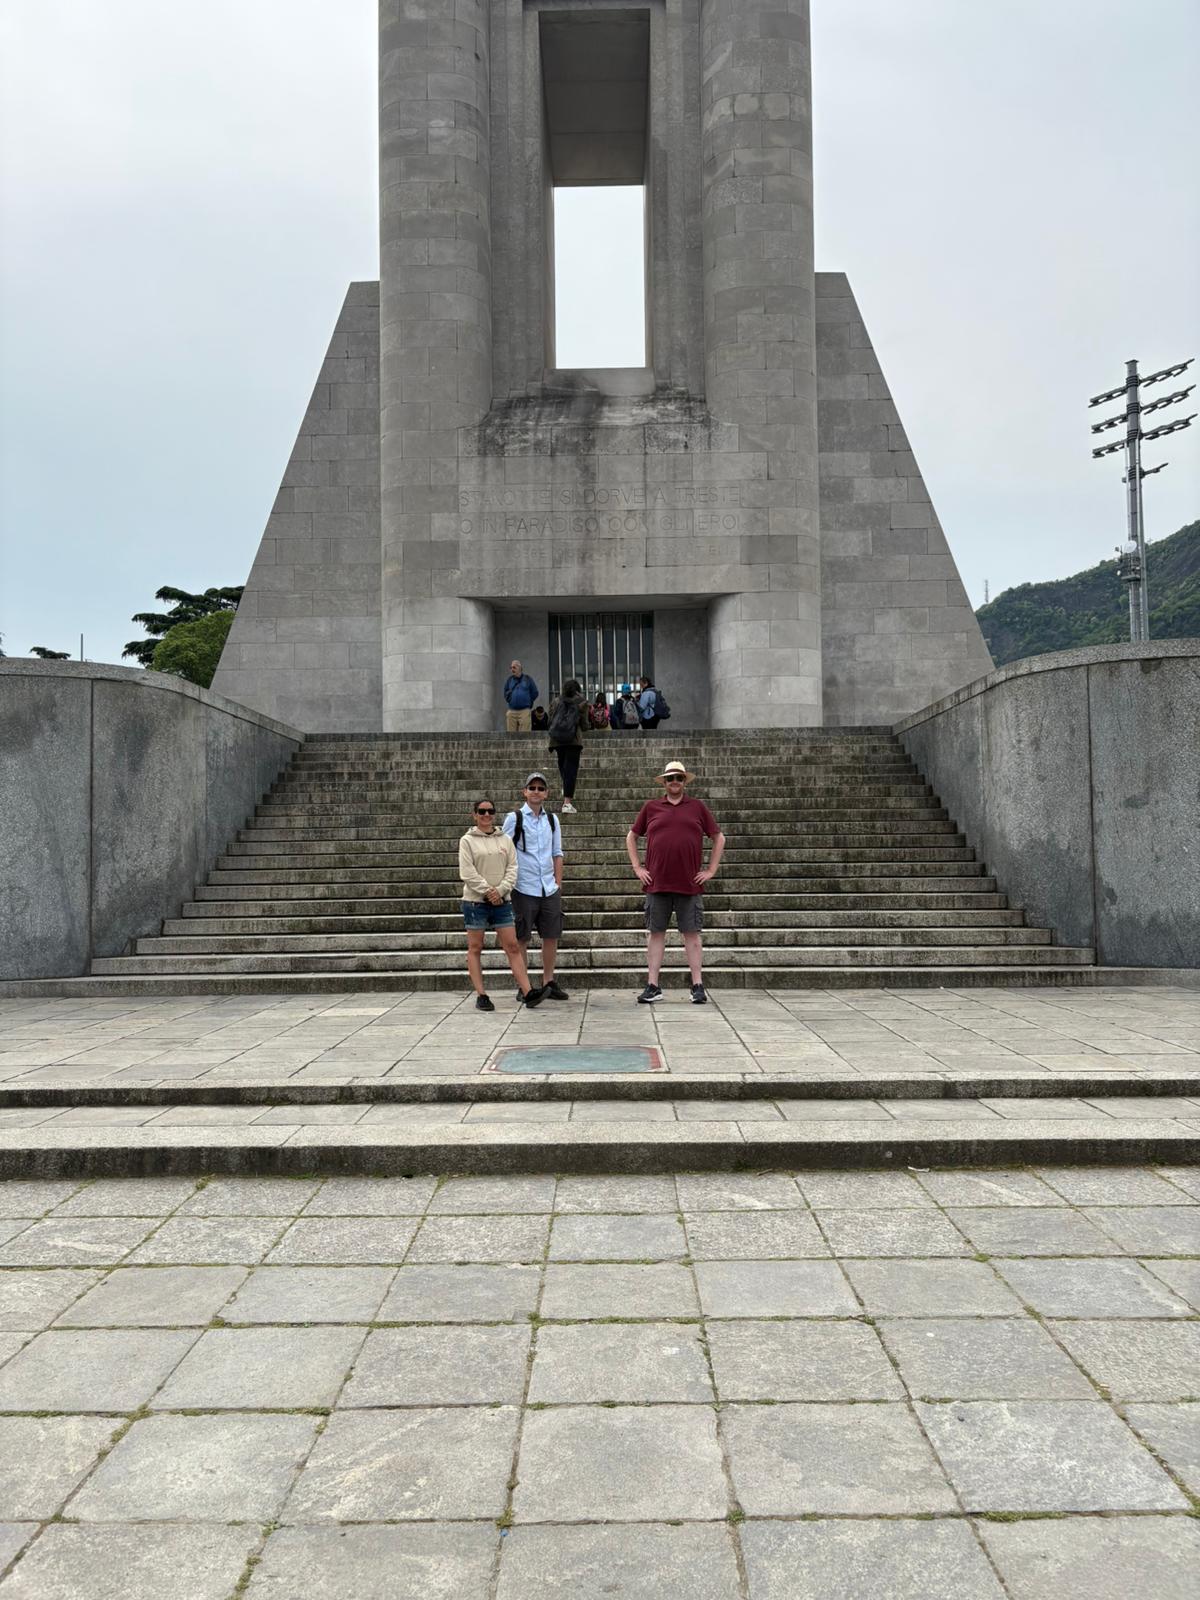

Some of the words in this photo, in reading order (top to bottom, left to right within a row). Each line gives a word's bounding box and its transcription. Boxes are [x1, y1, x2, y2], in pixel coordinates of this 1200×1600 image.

[560, 489, 575, 505] SI
[654, 487, 666, 504] A
[675, 486, 740, 504] TRESTE
[461, 518, 473, 534] O
[482, 518, 497, 534] IN
[505, 517, 599, 535] PARADISO
